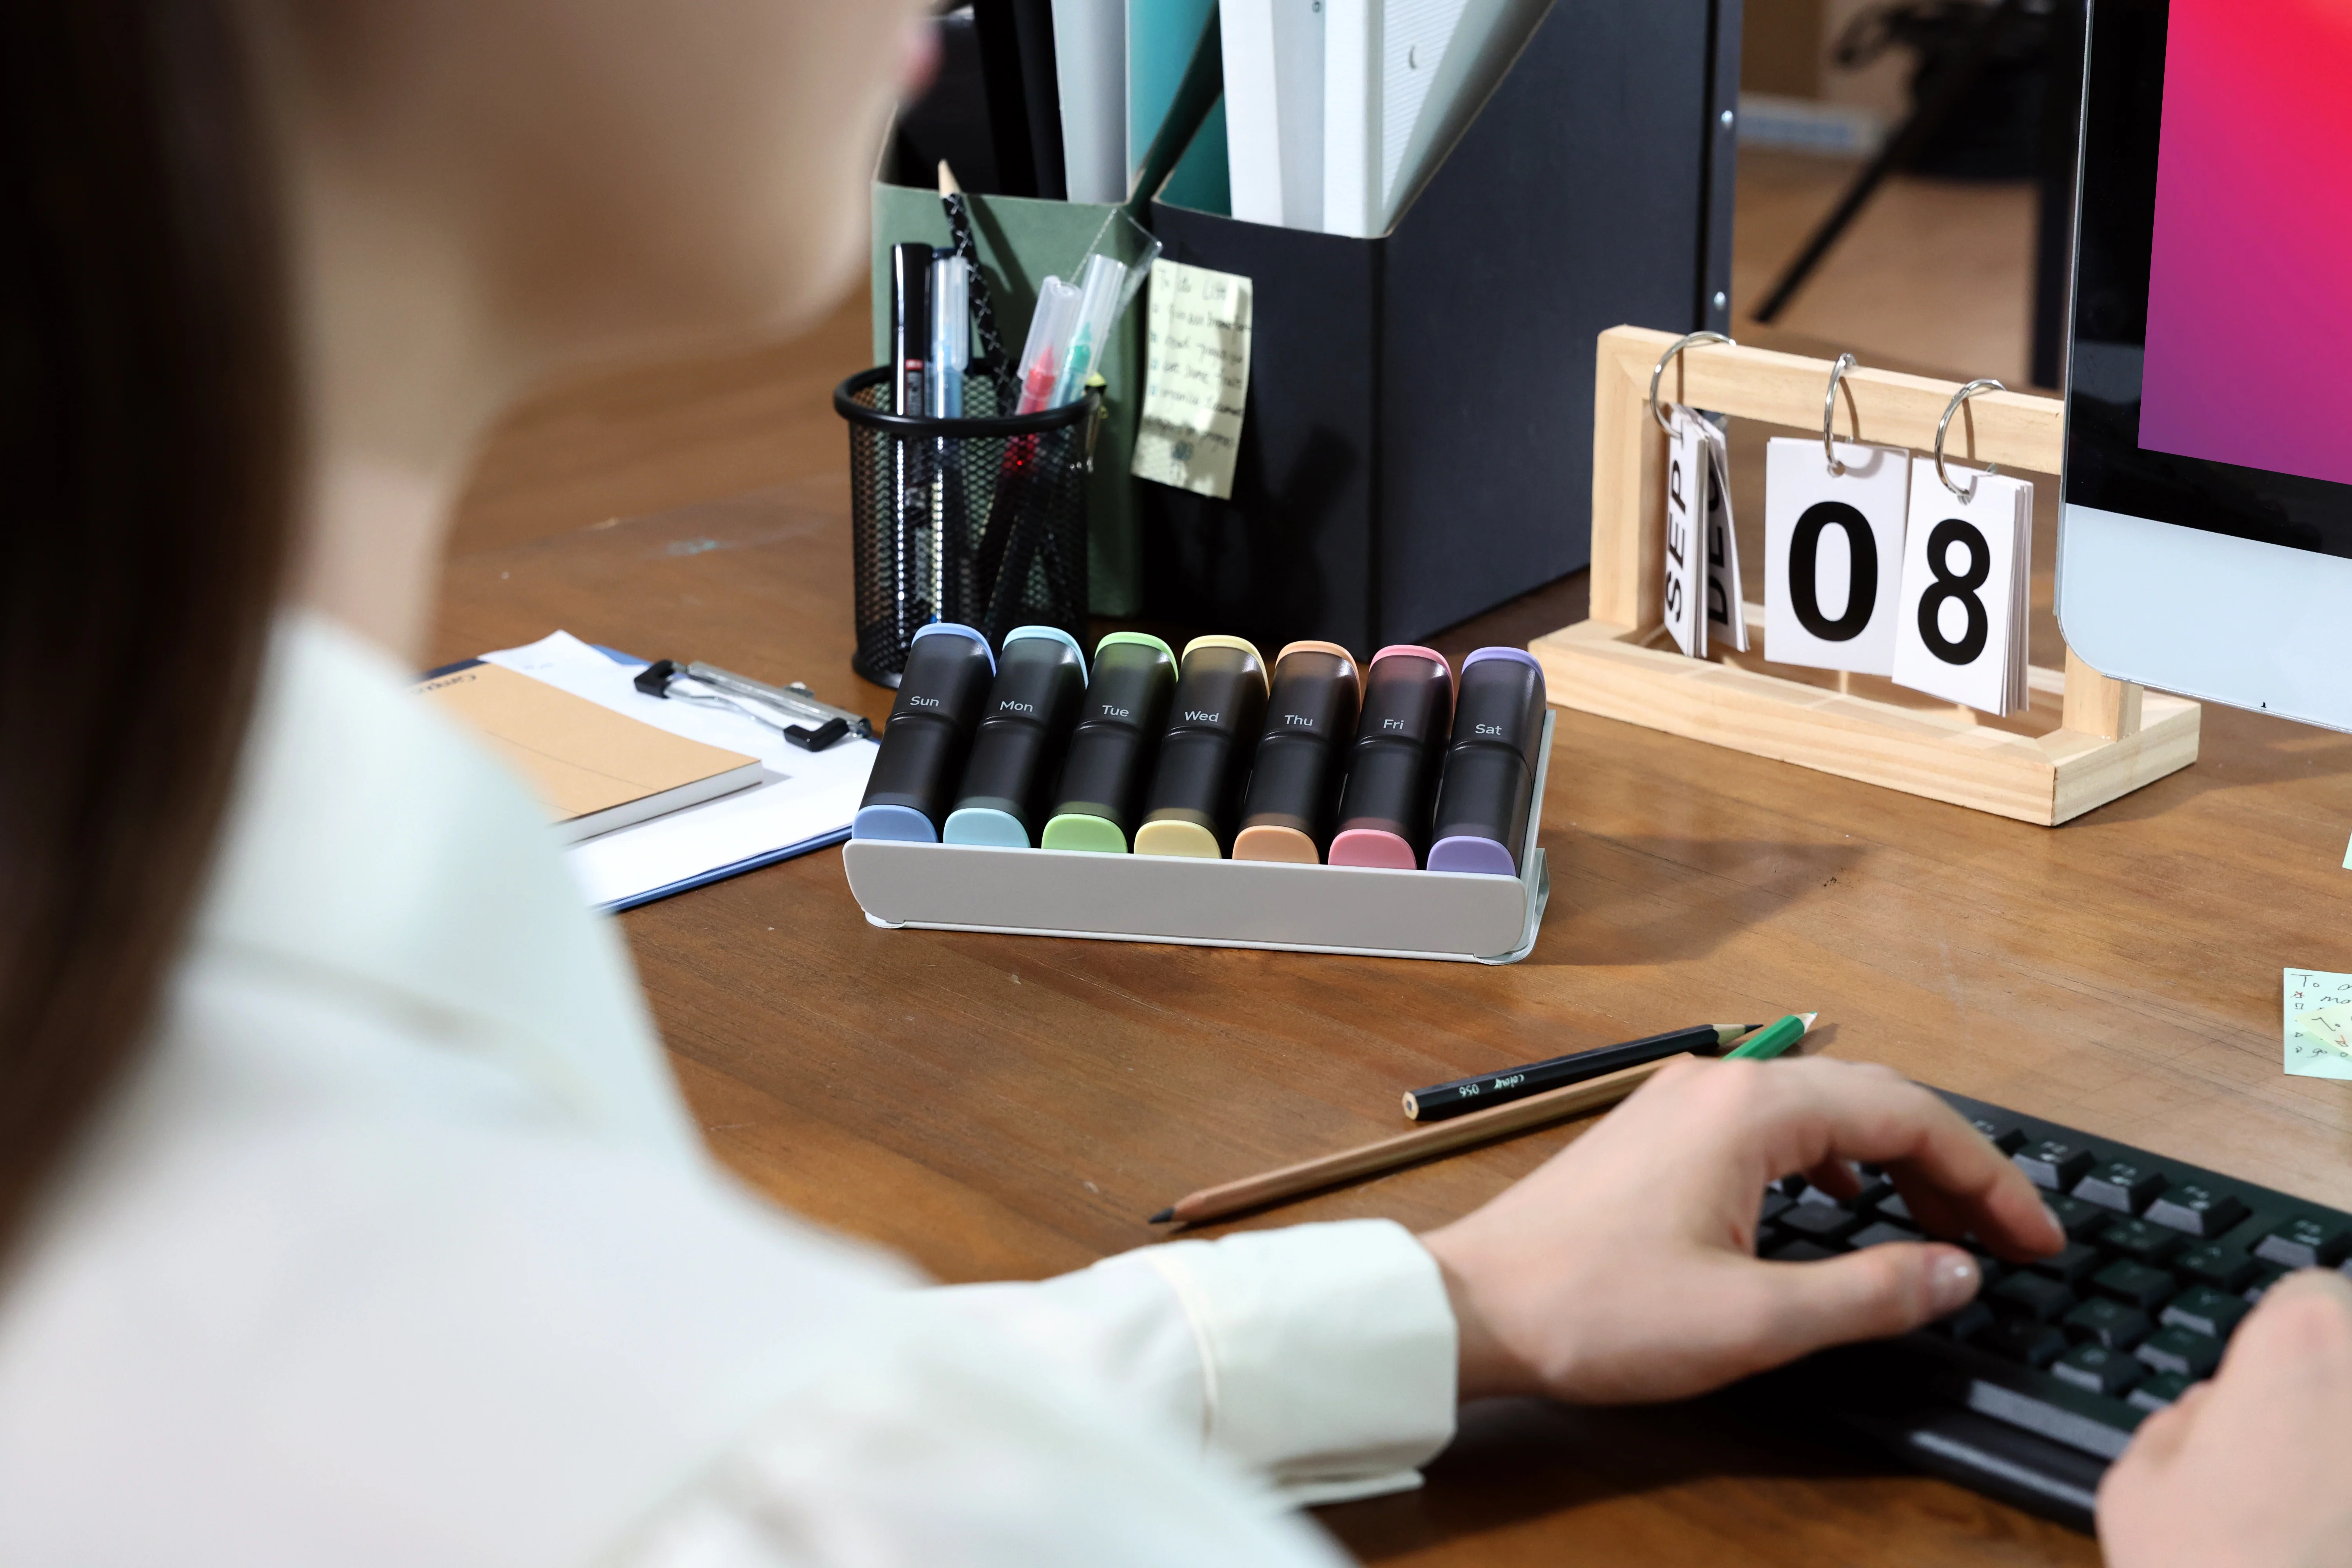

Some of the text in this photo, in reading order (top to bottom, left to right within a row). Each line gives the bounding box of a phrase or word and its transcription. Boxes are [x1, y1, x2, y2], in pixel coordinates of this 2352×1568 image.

[1666, 459, 1686, 622] SEP
[909, 696, 940, 708] Sun
[1000, 701, 1033, 713] Mon
[1102, 705, 1129, 717] Tue
[1184, 711, 1220, 723] Wed
[1284, 715, 1314, 726] Thu
[1383, 719, 1405, 730] Fri
[1475, 724, 1503, 735] Sat
[1459, 1084, 1480, 1097] 056
